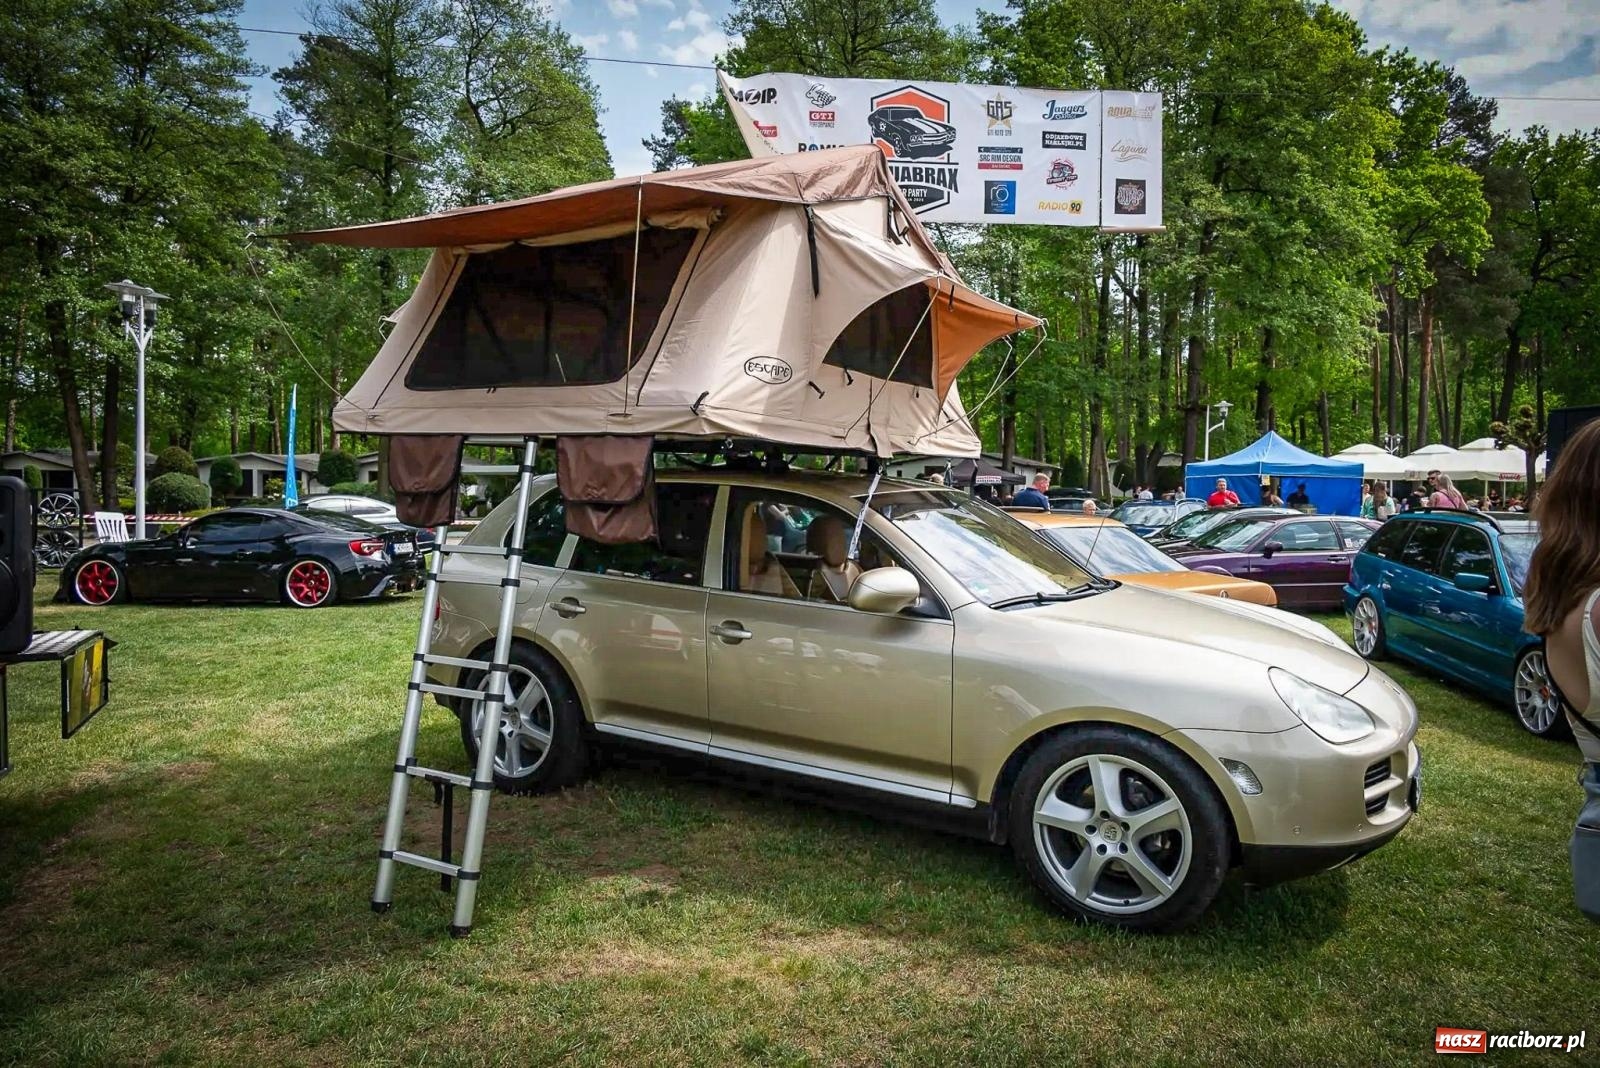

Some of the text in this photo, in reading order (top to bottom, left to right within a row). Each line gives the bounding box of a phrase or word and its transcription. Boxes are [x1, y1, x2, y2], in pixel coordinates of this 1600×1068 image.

[810, 112, 834, 120] GTI
[1002, 155, 1021, 163] DESIGN
[889, 166, 959, 193] UABRAX
[908, 188, 927, 197] PARTY
[1038, 201, 1081, 212] RADIO 90
[747, 361, 790, 378] ESCAPE
